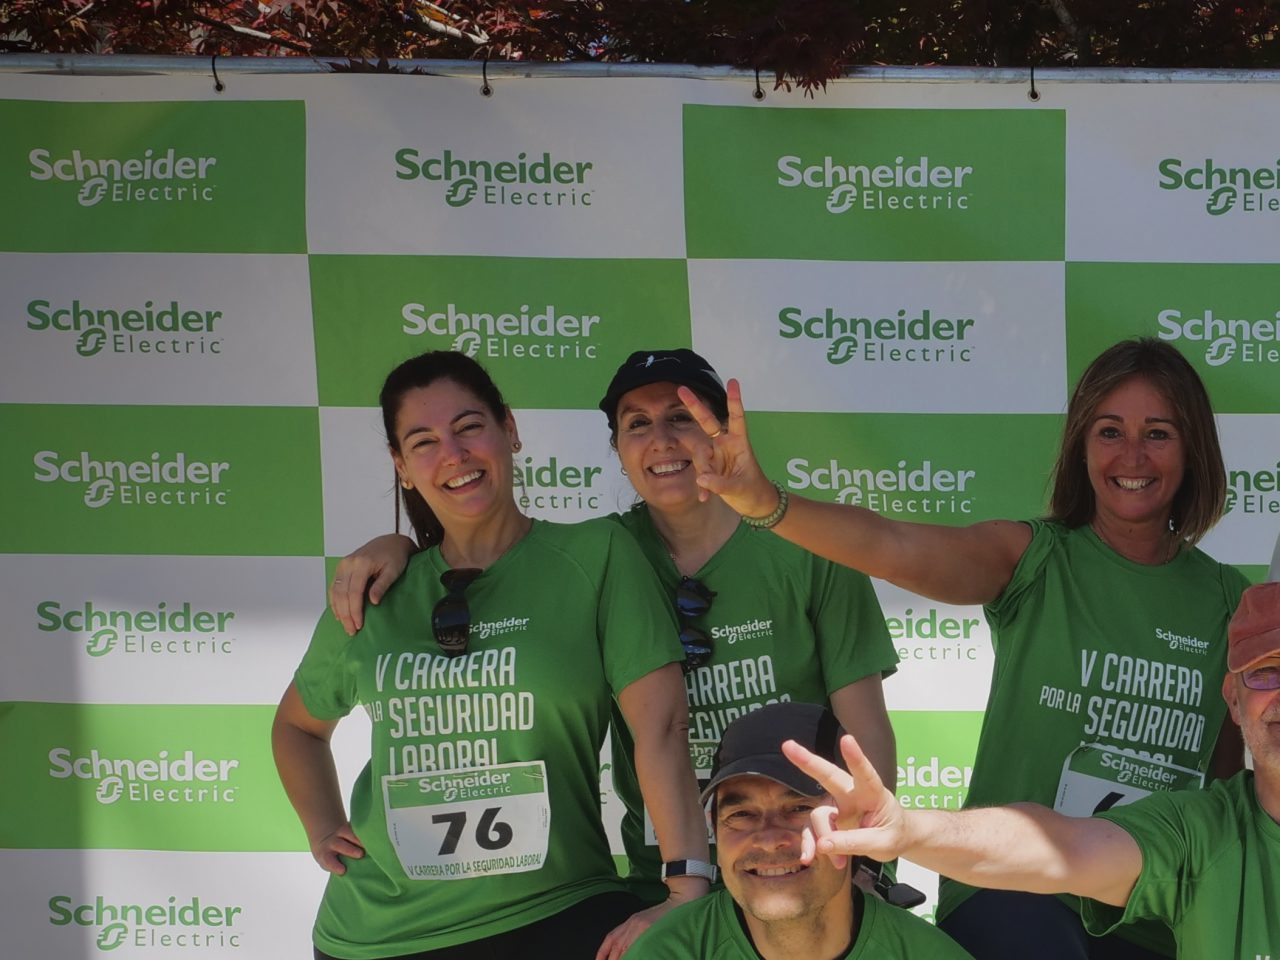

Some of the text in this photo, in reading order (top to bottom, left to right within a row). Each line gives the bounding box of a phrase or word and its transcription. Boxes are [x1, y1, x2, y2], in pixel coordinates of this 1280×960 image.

[29, 149, 216, 181] Schneider
[395, 149, 593, 184] Schneider
[777, 155, 972, 188] Schneider
[113, 184, 213, 202] Electric
[485, 186, 592, 206] Electric
[863, 191, 968, 210] Electric
[27, 300, 222, 333] Schneider
[402, 303, 600, 337] Schneider
[778, 307, 974, 341] Schneider
[113, 335, 221, 354] Electric
[487, 339, 596, 359] Electric
[864, 343, 970, 362] Electric
[34, 451, 229, 484] Schneider
[787, 458, 975, 491] Schneider
[120, 486, 227, 505] Electric
[519, 492, 598, 509] ectric
[869, 494, 971, 513] Electric
[37, 601, 235, 635] Schneider
[711, 619, 772, 639] Schneider
[887, 608, 979, 639] eider
[126, 635, 232, 654] Electric
[739, 629, 773, 641] Electric
[1156, 628, 1209, 649] Schneider
[898, 644, 976, 660] ectric
[395, 647, 516, 690] CARRERA
[1081, 649, 1203, 707] V CARRERA
[685, 655, 776, 707] ARRERA
[389, 691, 534, 738] SEGURIDAD
[1039, 685, 1065, 709] POR
[1066, 692, 1082, 714] LA
[1084, 696, 1206, 753] SEGURIDAD
[49, 747, 239, 782] Schneider
[1101, 753, 1177, 784] Schneider
[129, 783, 234, 803] Electric
[419, 771, 510, 793] Schneider
[460, 785, 511, 798] Electric
[900, 791, 961, 808] ectri
[432, 807, 513, 856] 76
[413, 863, 444, 876] CARRERA
[445, 863, 461, 875] POR
[462, 862, 472, 873] LA
[473, 857, 514, 872] SEGURIDAD
[515, 853, 542, 867] LABORAL
[49, 896, 241, 928] Schneider
[135, 929, 240, 948] Electric
